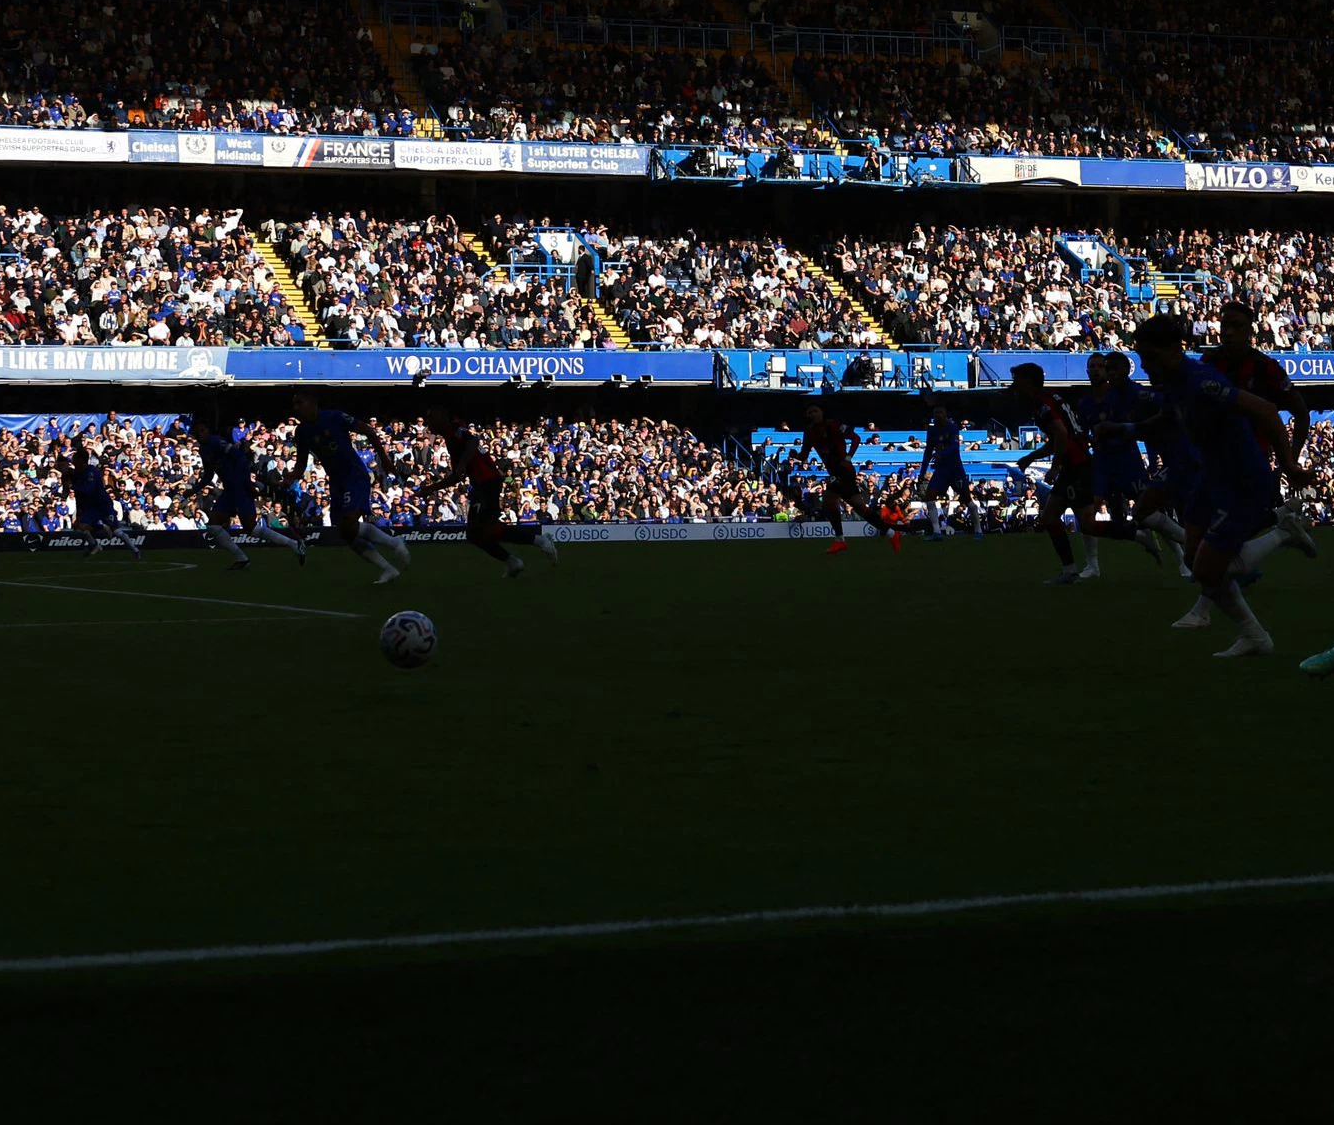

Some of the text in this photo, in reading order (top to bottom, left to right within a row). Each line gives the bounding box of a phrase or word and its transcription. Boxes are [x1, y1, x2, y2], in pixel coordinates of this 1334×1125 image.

[27, 137, 64, 145] FOOTBALL
[65, 138, 84, 146] CLUB
[132, 141, 176, 153] Chelsea
[226, 138, 252, 149] West
[323, 142, 391, 157] FRANCE
[528, 146, 640, 159] 1st. ULSTER CHELSEA
[217, 150, 261, 161] Midlands
[323, 156, 390, 165] SUPPORTERS CLUB
[399, 155, 492, 166] SUPPORTERS CLUB
[527, 158, 619, 170] Supporters Club
[1205, 166, 1268, 189] MIZO
[550, 235, 558, 248] 3
[1076, 244, 1084, 255] 4
[9, 350, 49, 371] LIKE
[53, 351, 89, 371] RAY
[91, 350, 178, 372] ANYMORE
[385, 355, 584, 376] WORLD CHAMPIONS
[401, 530, 432, 541] nike
[573, 528, 609, 540] USDC
[652, 528, 688, 539] USDC
[730, 527, 765, 538] USDC
[48, 536, 82, 547] nike
